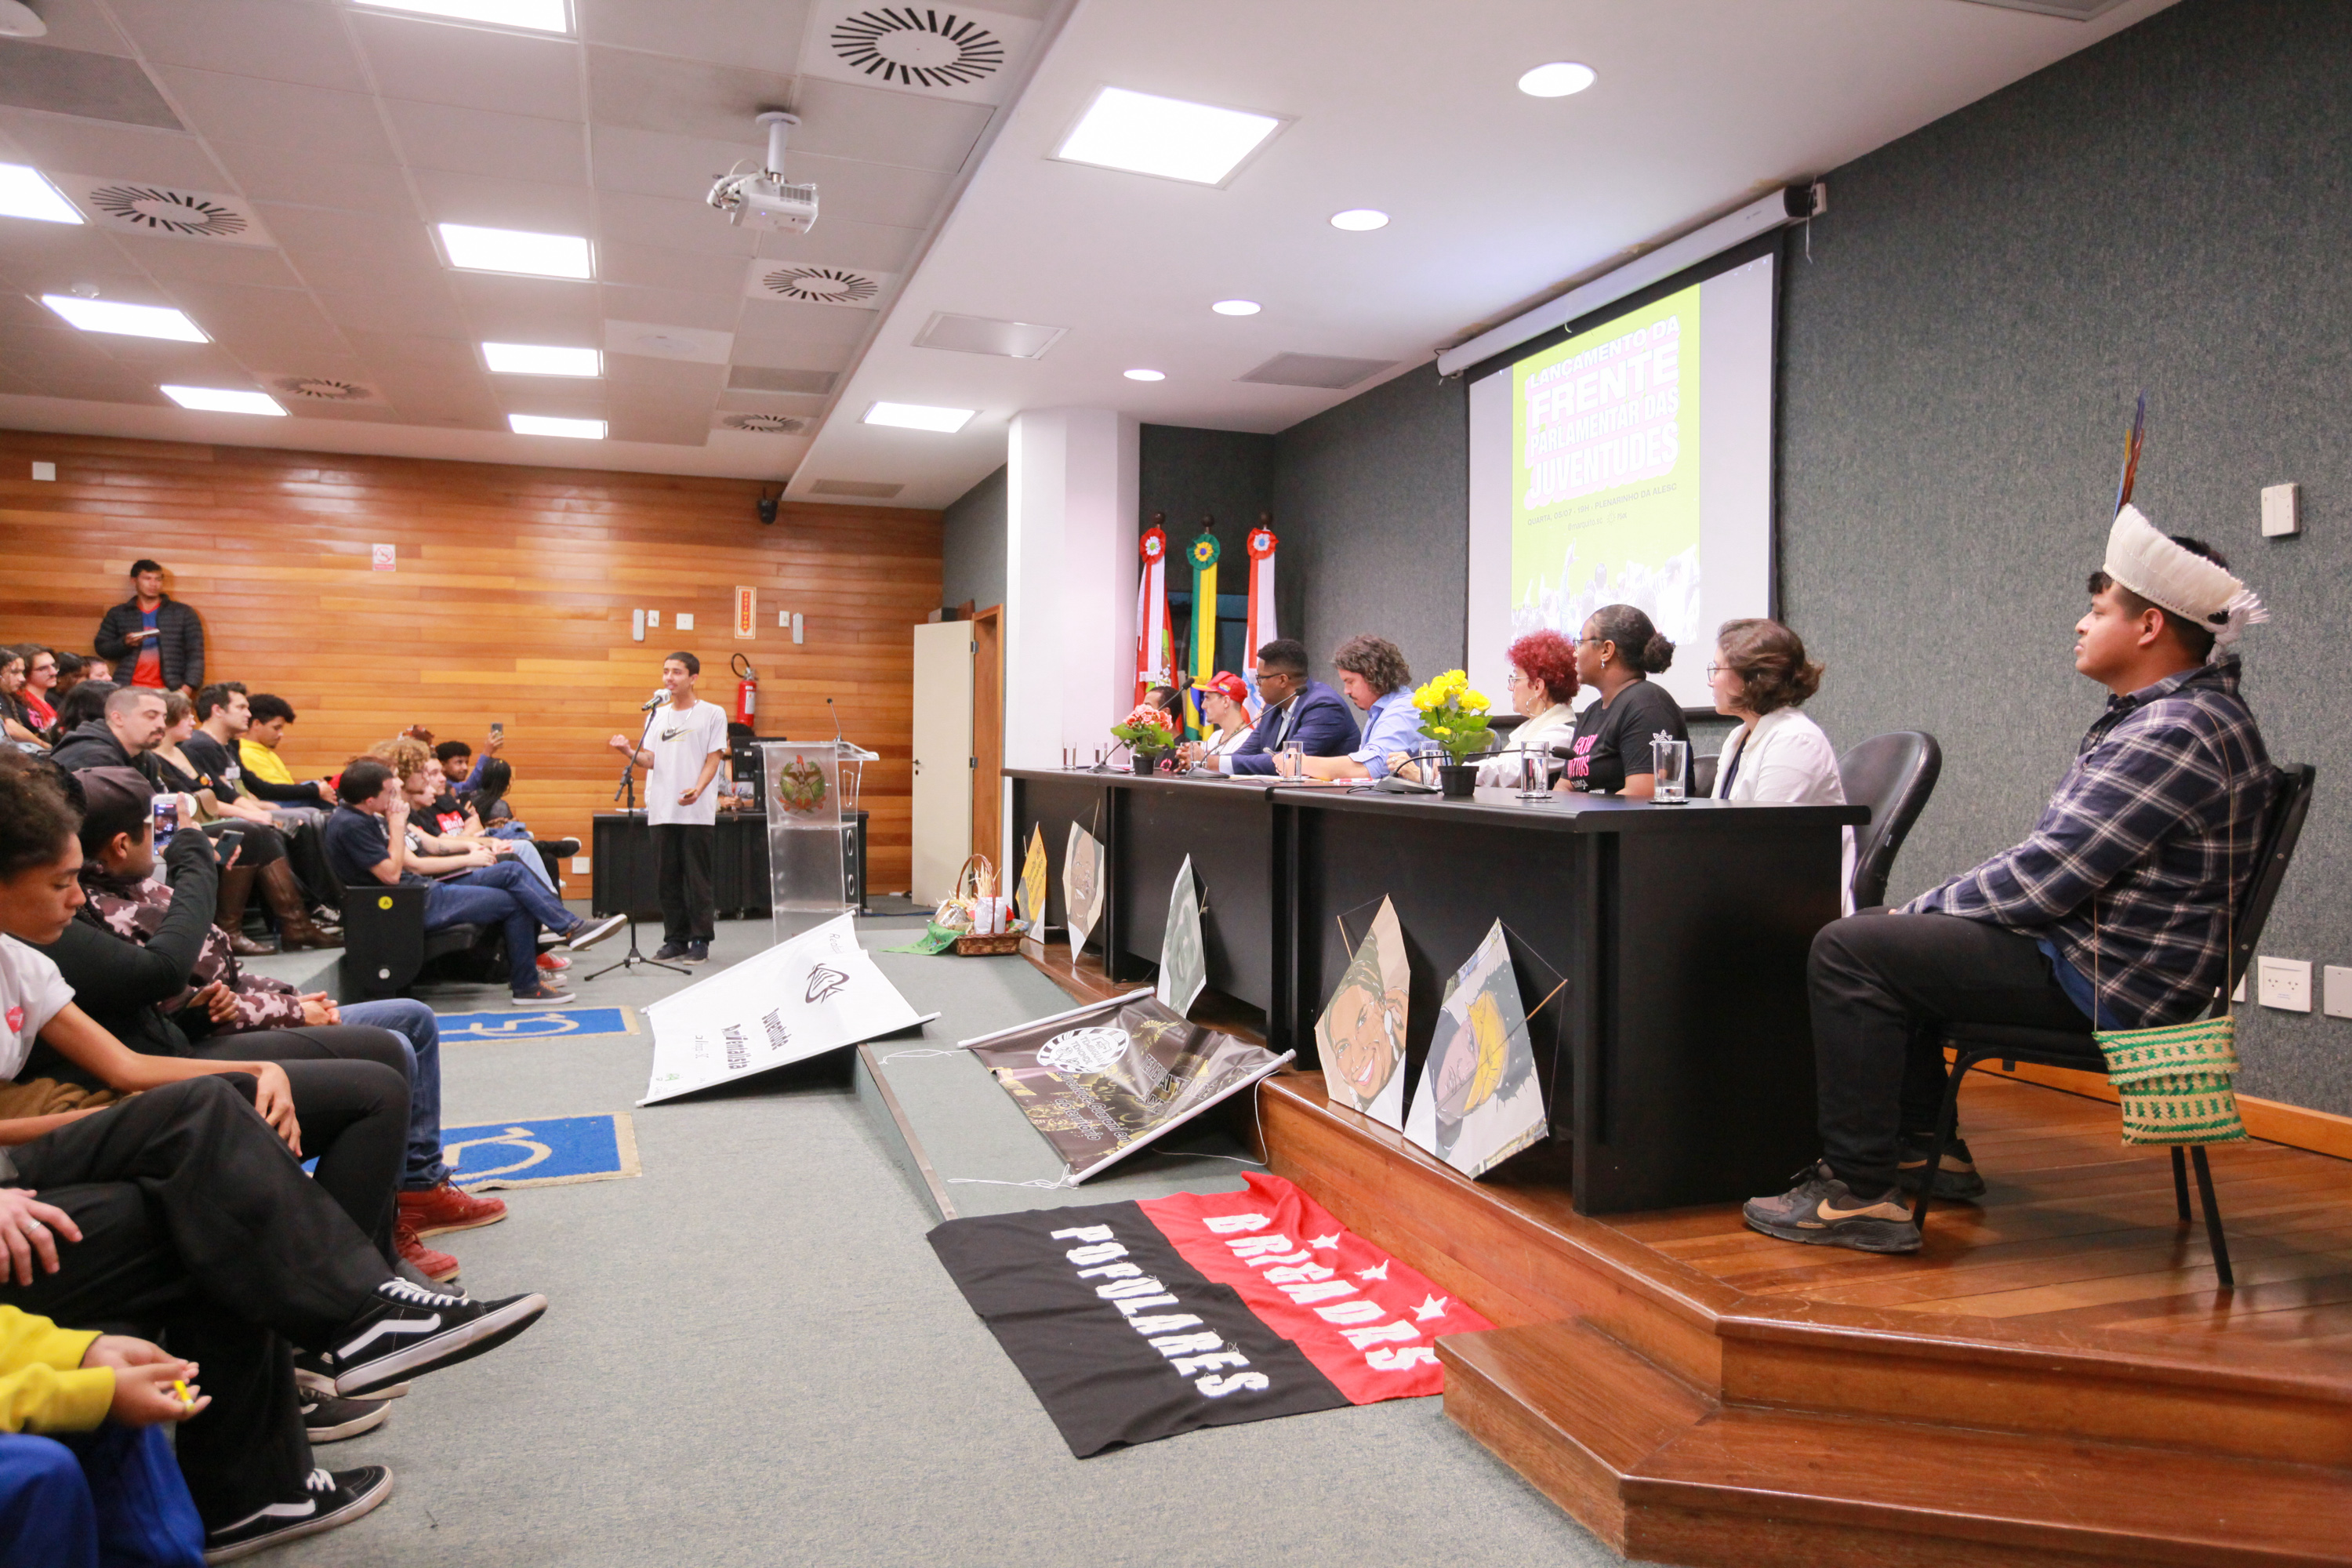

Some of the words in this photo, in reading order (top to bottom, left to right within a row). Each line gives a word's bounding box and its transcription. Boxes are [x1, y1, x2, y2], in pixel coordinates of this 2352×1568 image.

[1530, 328, 1646, 388] LANÇAMENTO
[1652, 314, 1680, 340] DA
[1531, 338, 1679, 429] FRENTE
[1530, 398, 1640, 458] PARLAMENTAR
[1644, 386, 1679, 419] DAS
[1529, 421, 1679, 500] JUVENTUDES
[1595, 492, 1639, 510] PLENARINHO
[1640, 489, 1651, 499] DA
[1652, 483, 1677, 495] ALESC
[761, 1007, 792, 1051] Juventude
[1055, 1098, 1076, 1109] do
[1057, 1072, 1098, 1103] Juventude
[1087, 1102, 1128, 1132] Guarani
[1051, 1224, 1269, 1398] POPULARES
[1203, 1213, 1441, 1370] BRIGADAS
